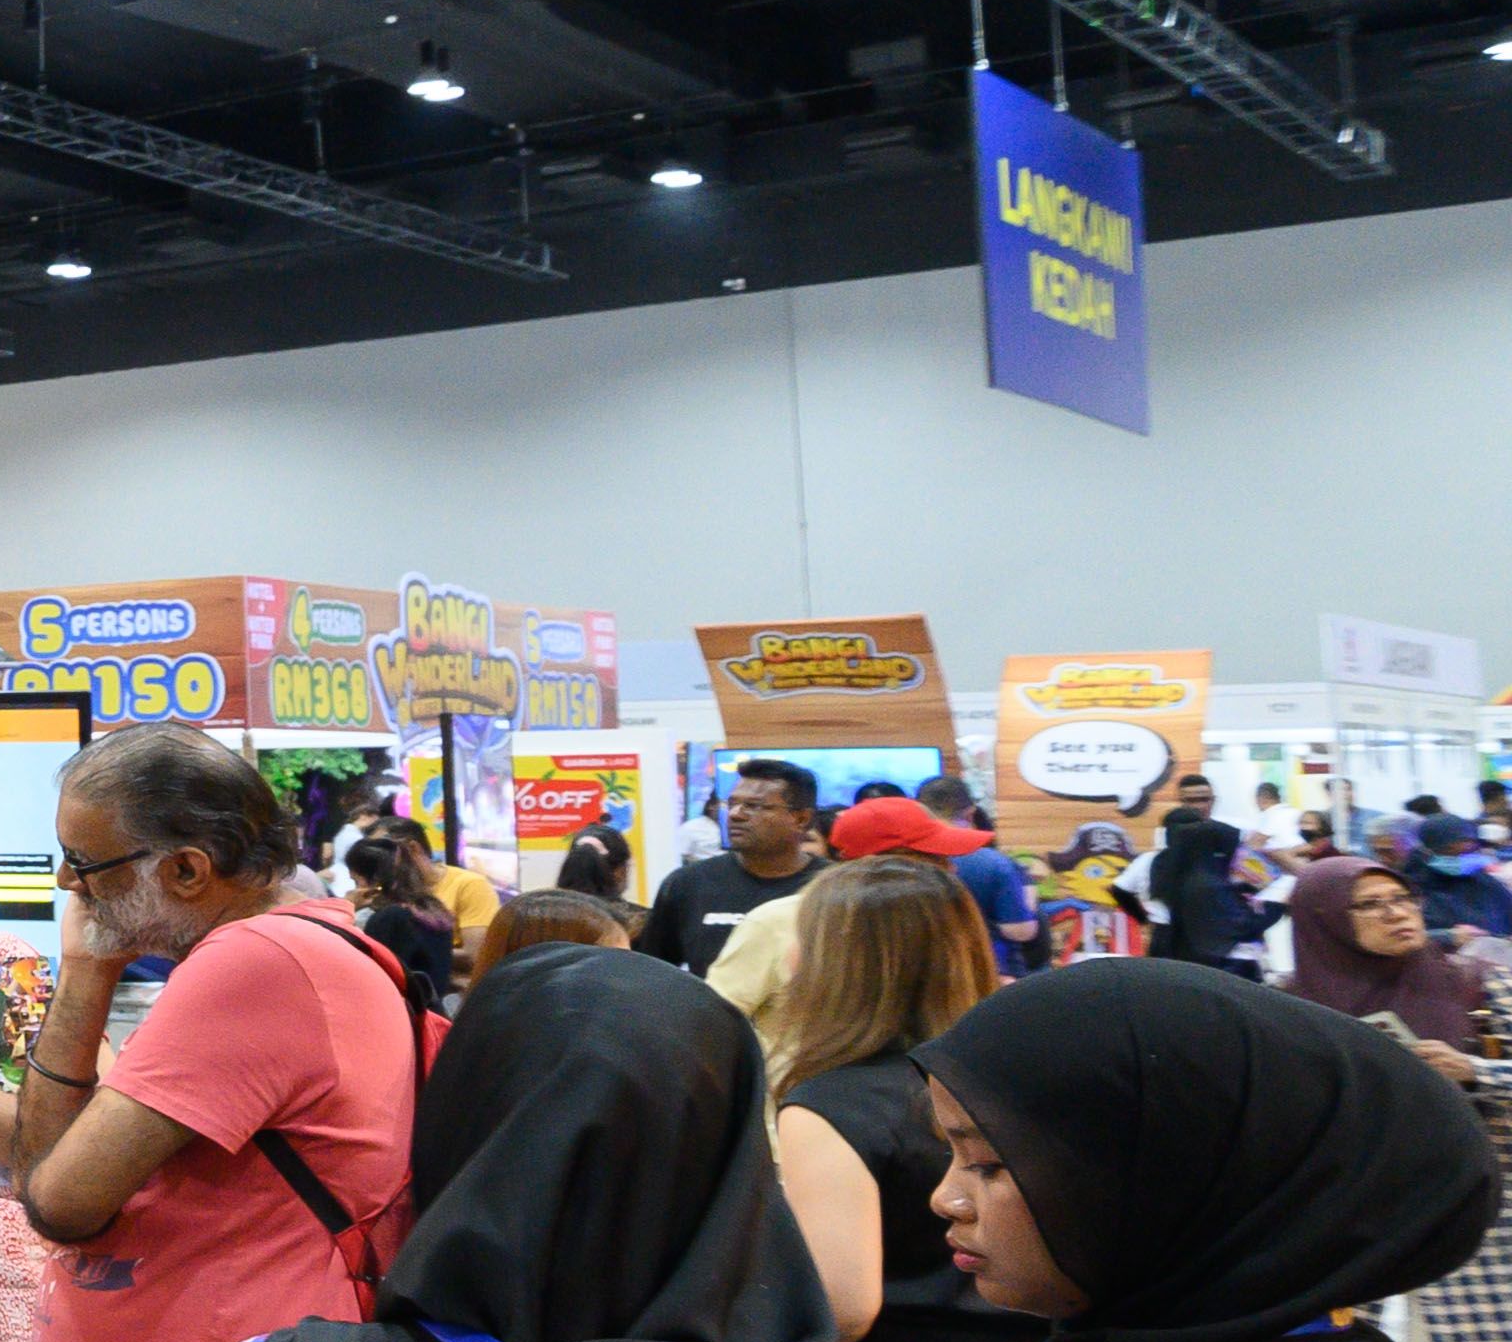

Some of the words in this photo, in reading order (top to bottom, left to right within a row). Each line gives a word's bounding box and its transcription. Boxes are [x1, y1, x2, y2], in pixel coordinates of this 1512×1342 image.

[70, 606, 186, 639] PERSONS
[406, 581, 490, 655] BANGI
[273, 659, 370, 721] RM368
[538, 789, 600, 810] OFF
